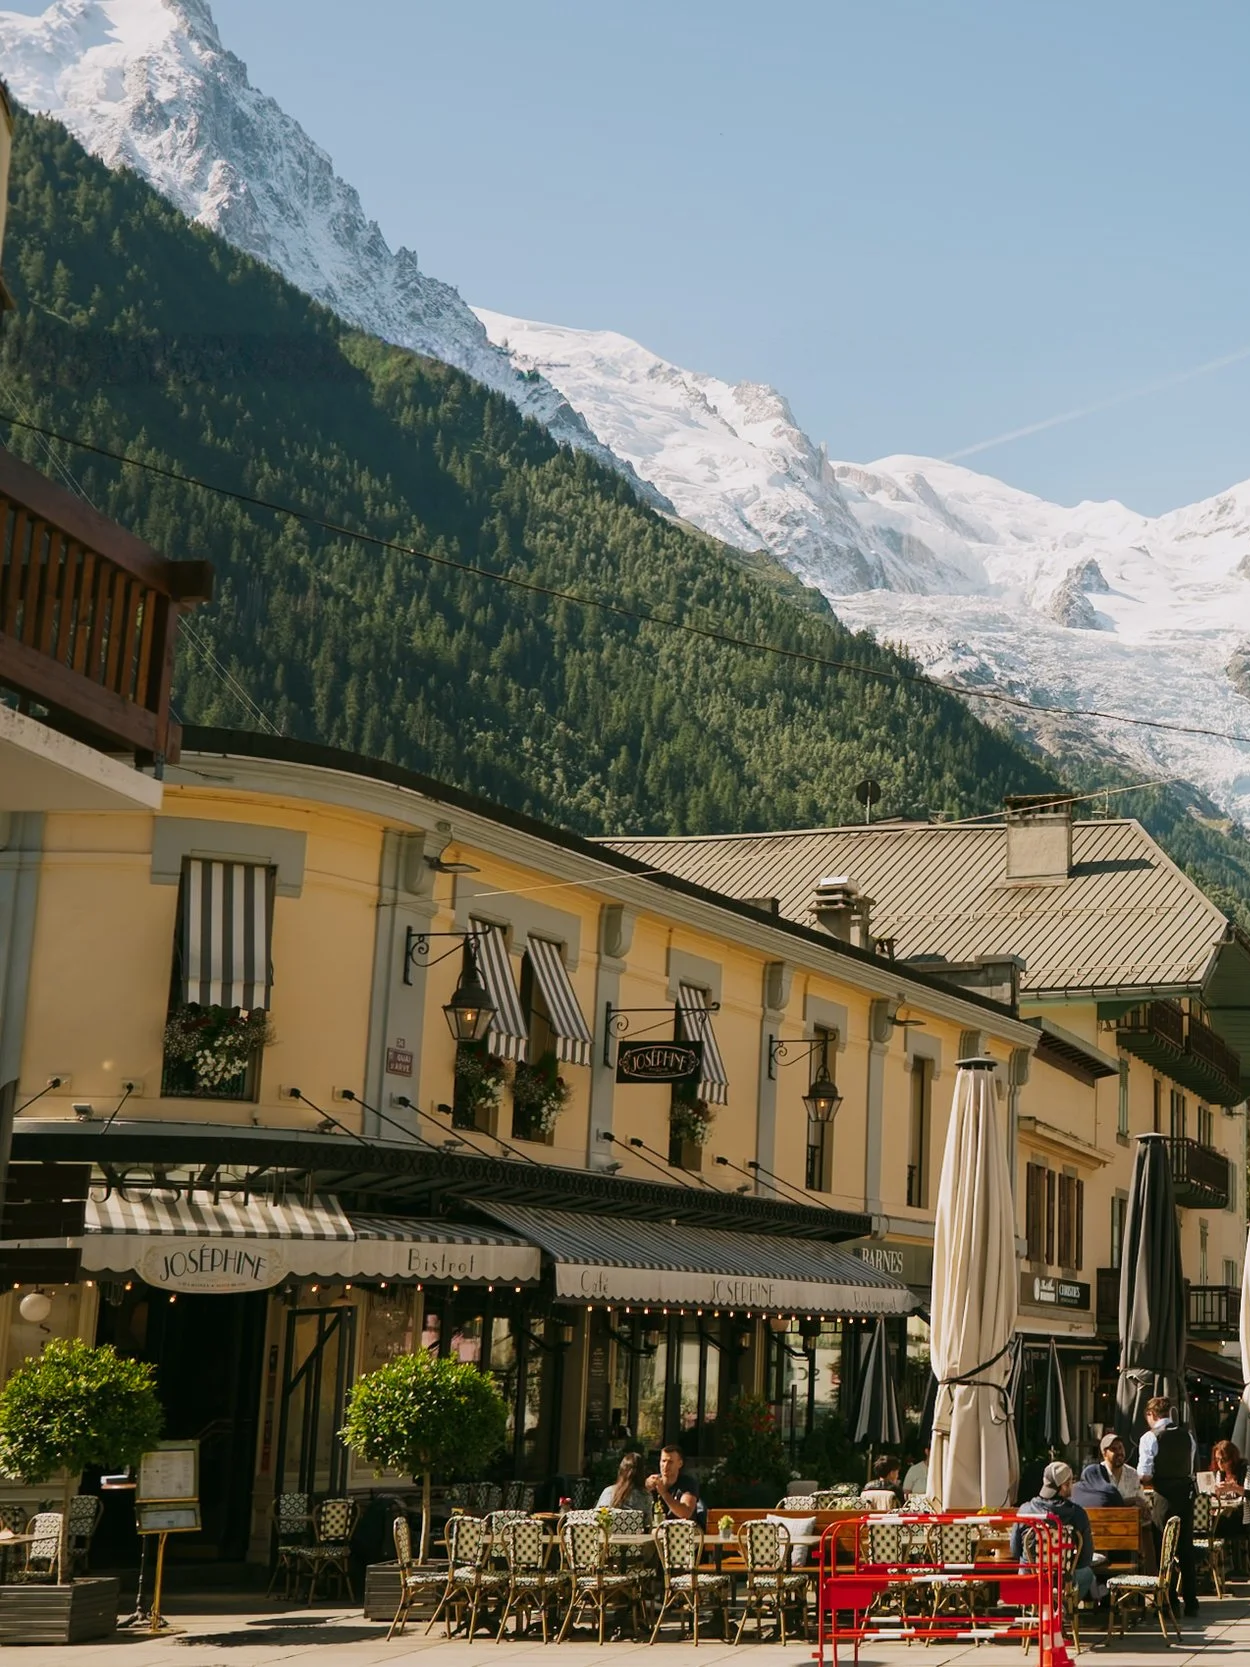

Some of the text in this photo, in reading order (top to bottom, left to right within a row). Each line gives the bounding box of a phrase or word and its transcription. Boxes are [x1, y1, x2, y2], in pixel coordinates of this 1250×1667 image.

[159, 1243, 267, 1282] JOSÉPHINE
[407, 1248, 474, 1273] Bistrot
[861, 1247, 904, 1274] BARNES
